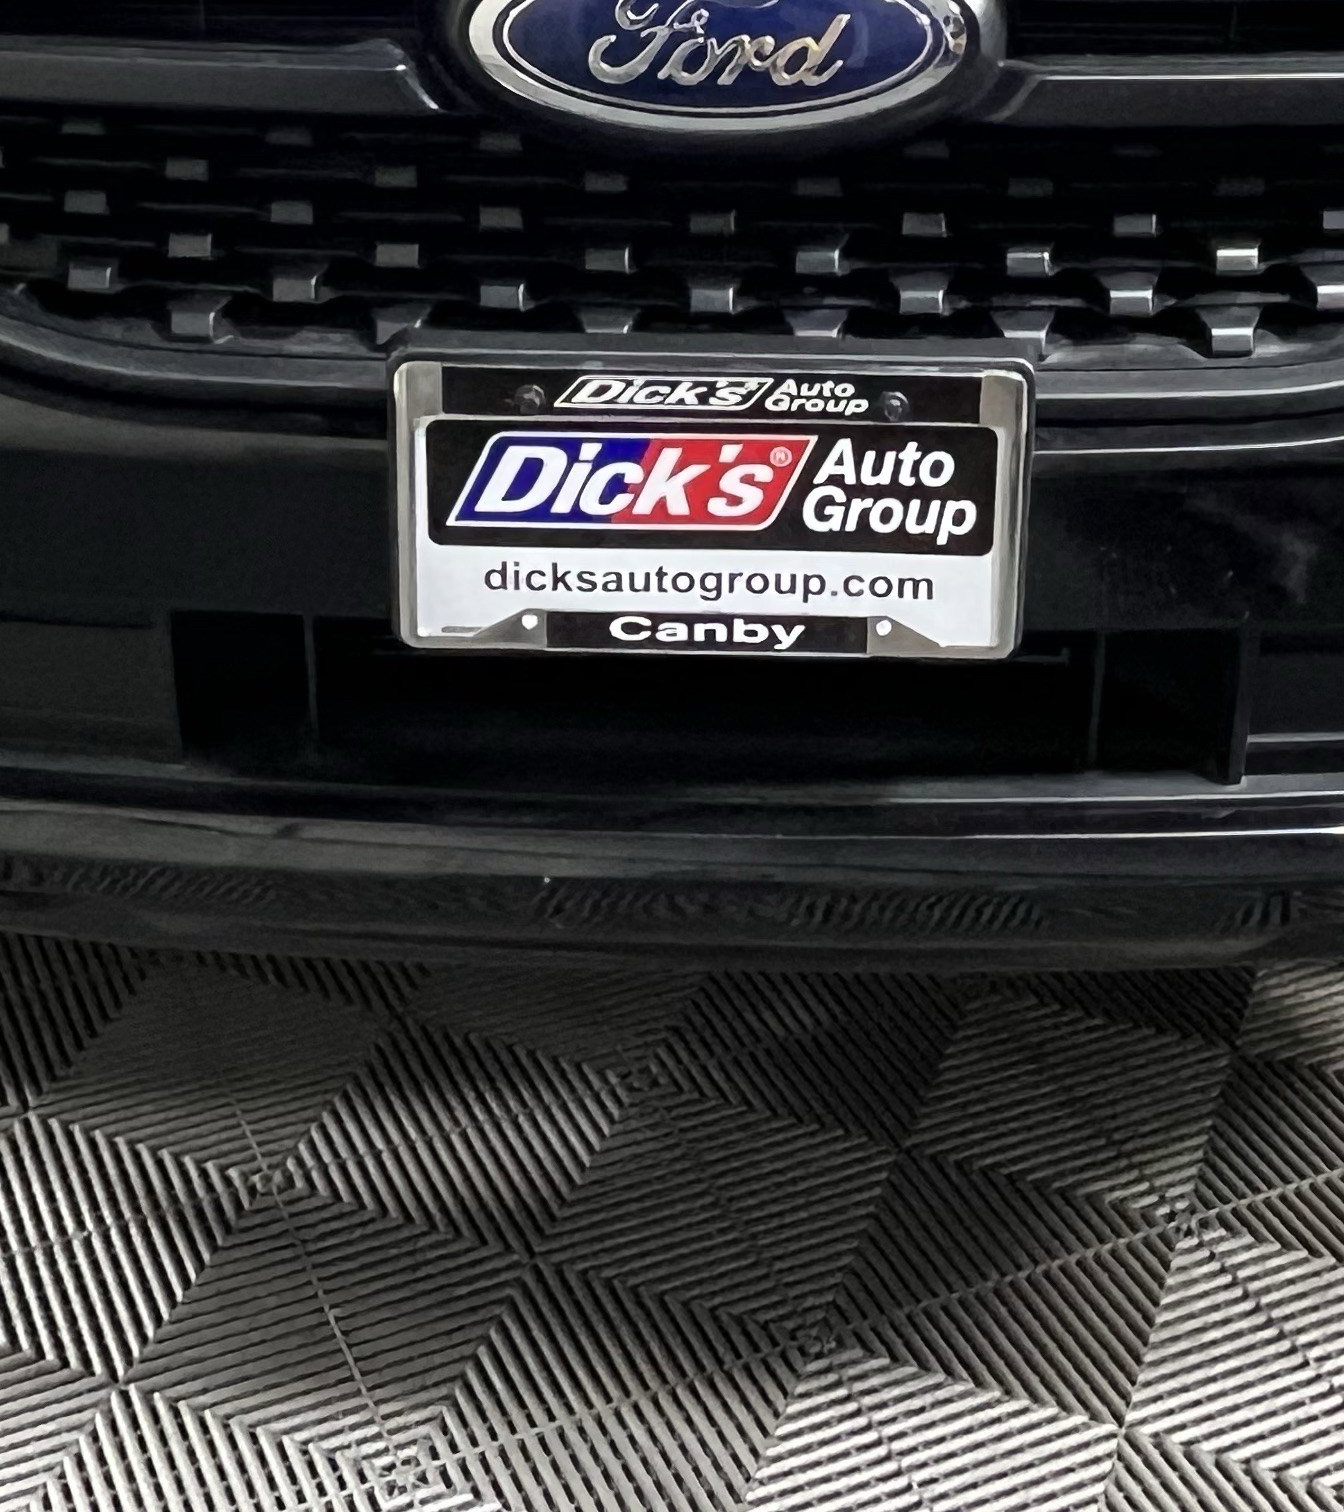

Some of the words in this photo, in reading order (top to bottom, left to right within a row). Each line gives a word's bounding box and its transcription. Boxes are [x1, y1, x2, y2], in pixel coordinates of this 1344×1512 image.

[764, 395, 870, 416] Group
[778, 380, 856, 397] Auto
[813, 438, 955, 488] Auto
[802, 486, 977, 546] Group
[483, 561, 935, 601] dicksautogroup.com
[608, 615, 806, 650] Canby
